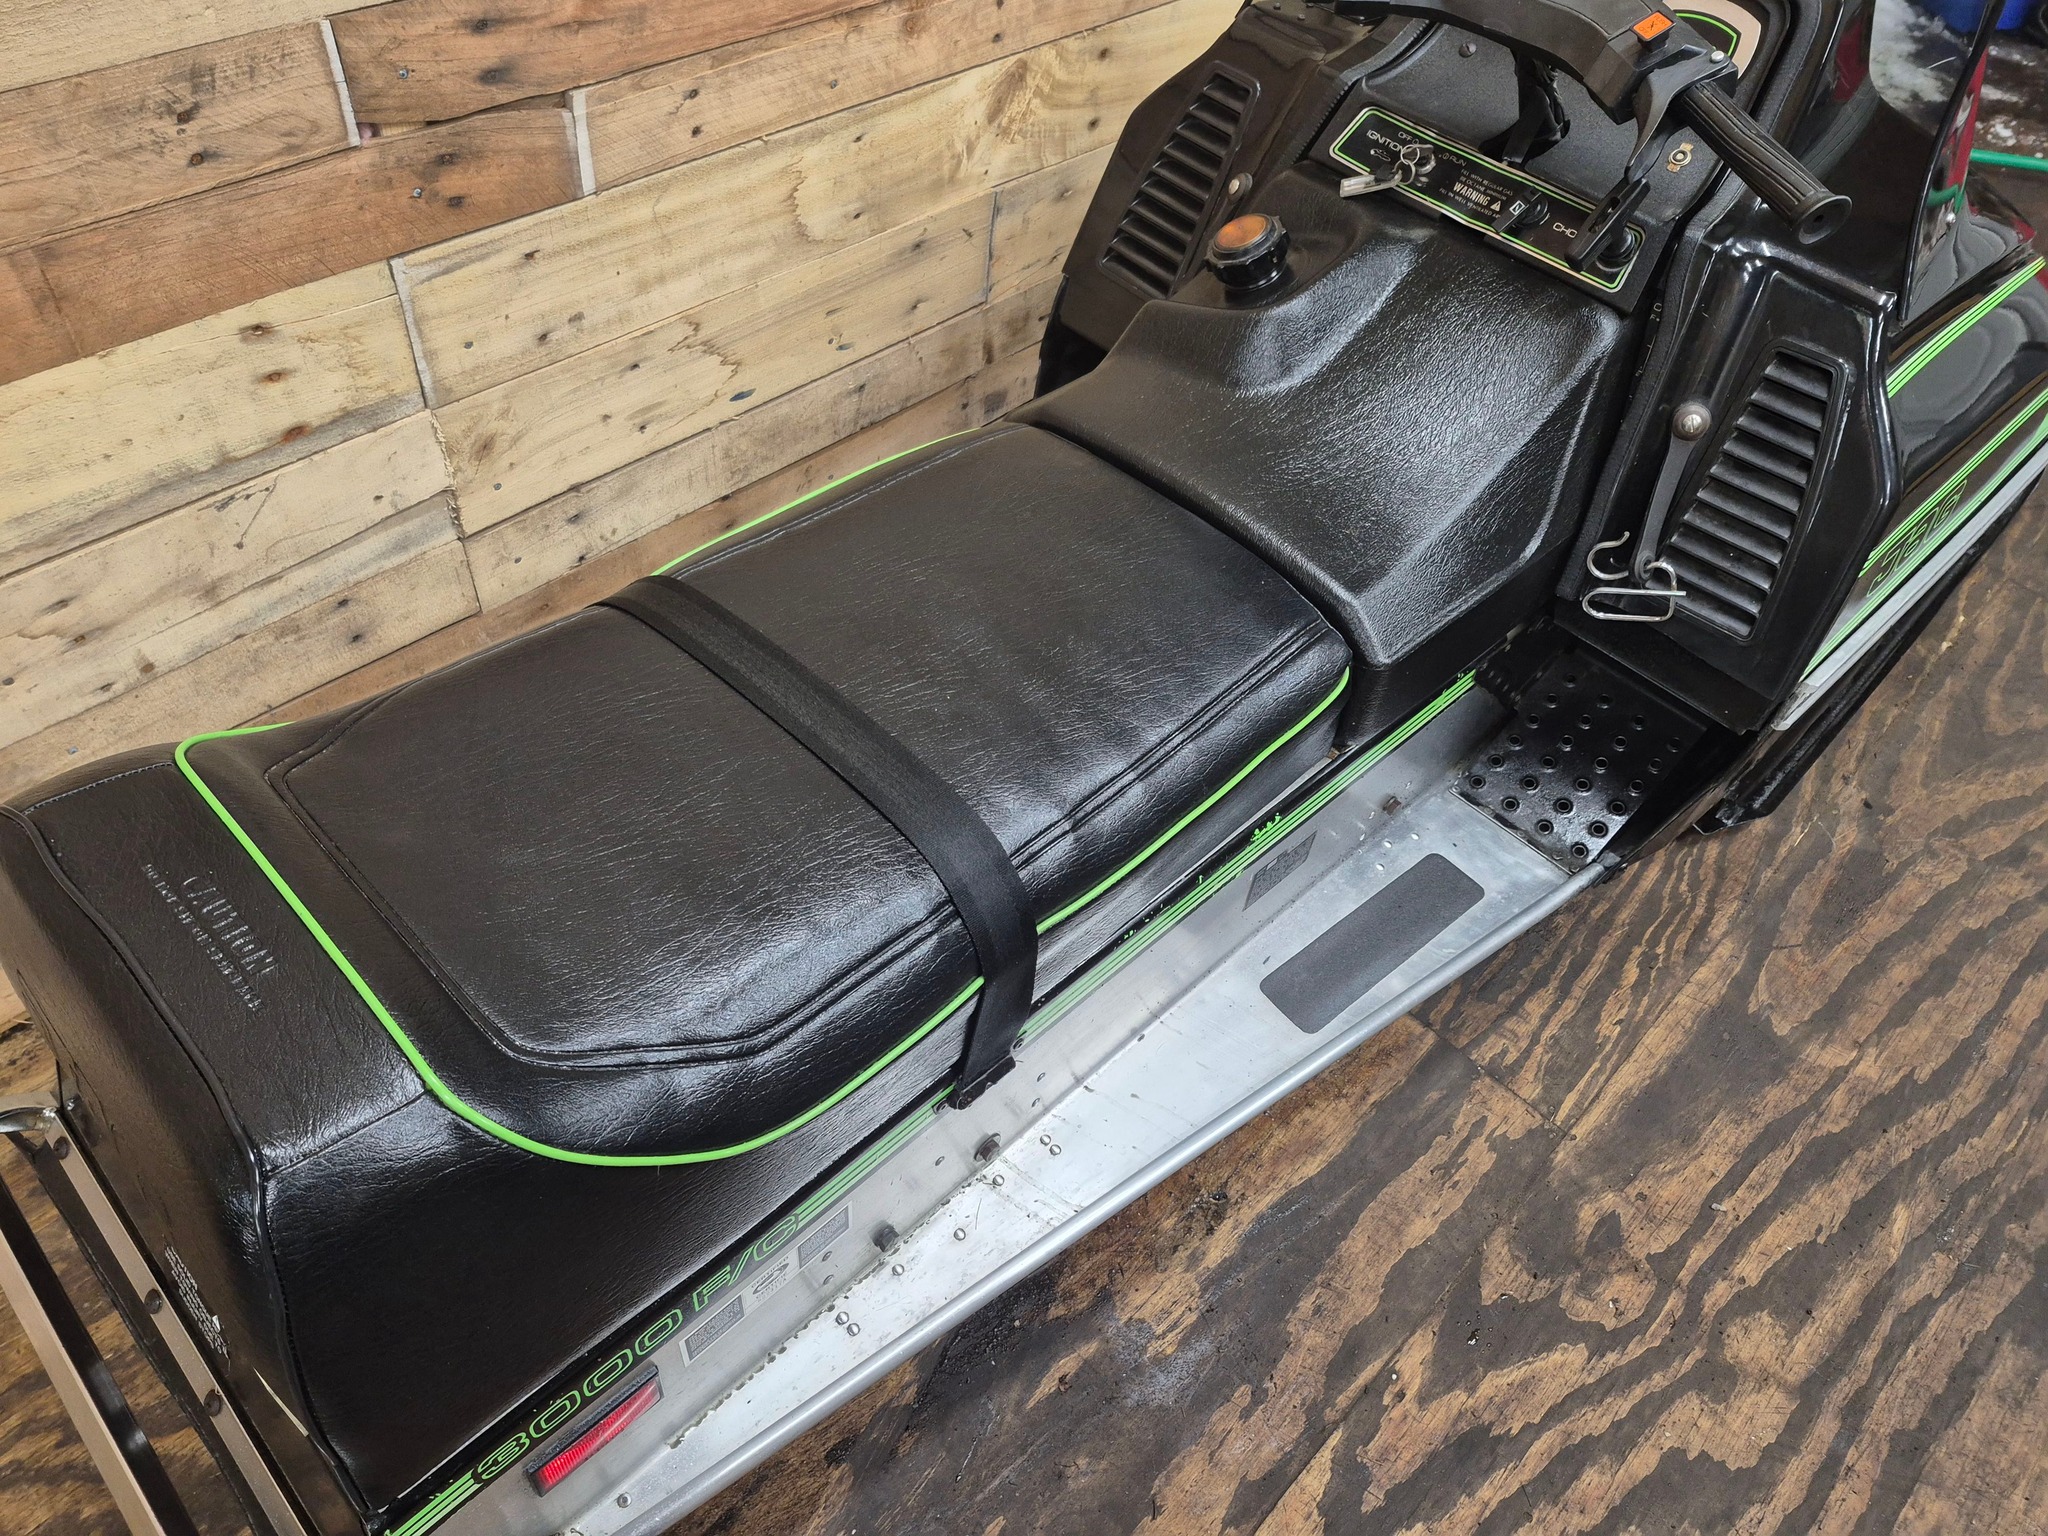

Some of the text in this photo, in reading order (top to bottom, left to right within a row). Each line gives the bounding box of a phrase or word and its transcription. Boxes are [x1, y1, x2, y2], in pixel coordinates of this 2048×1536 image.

[1366, 129, 1403, 152] IGNITION
[1398, 131, 1413, 142] OFF
[1449, 155, 1467, 167] RUN
[1453, 181, 1491, 206] WARNING
[1553, 222, 1578, 239] CHO
[477, 1309, 683, 1481] 3000
[692, 1214, 797, 1313] F/C
